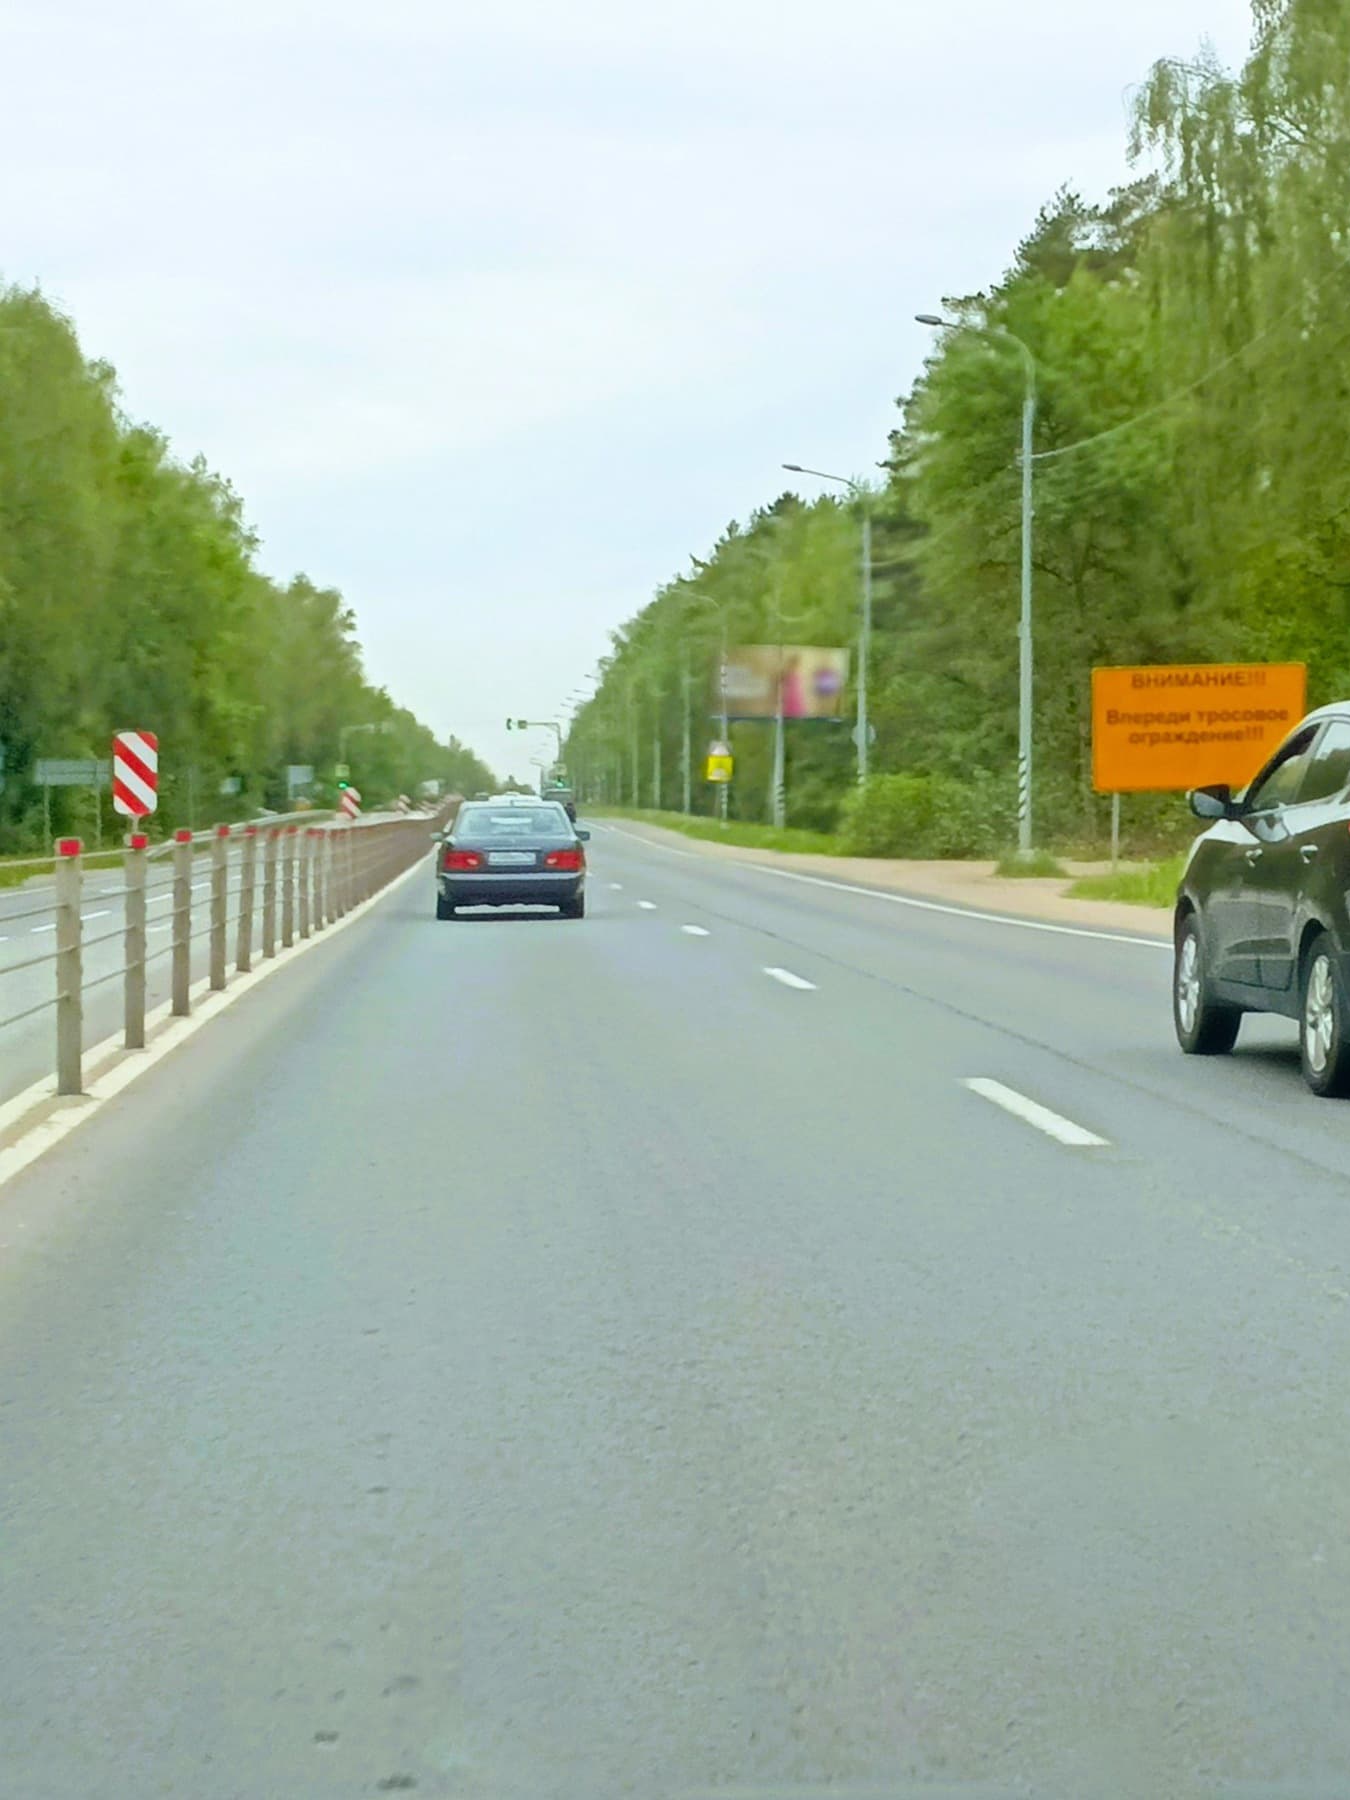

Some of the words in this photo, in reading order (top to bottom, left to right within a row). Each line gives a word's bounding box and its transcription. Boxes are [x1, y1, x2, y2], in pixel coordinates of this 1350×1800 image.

[1131, 671, 1266, 688] ВНИМАНИЕ!!!
[1106, 709, 1190, 727] Впереди
[1197, 709, 1288, 725] тросовое
[1129, 726, 1264, 746] ограждение!!!
